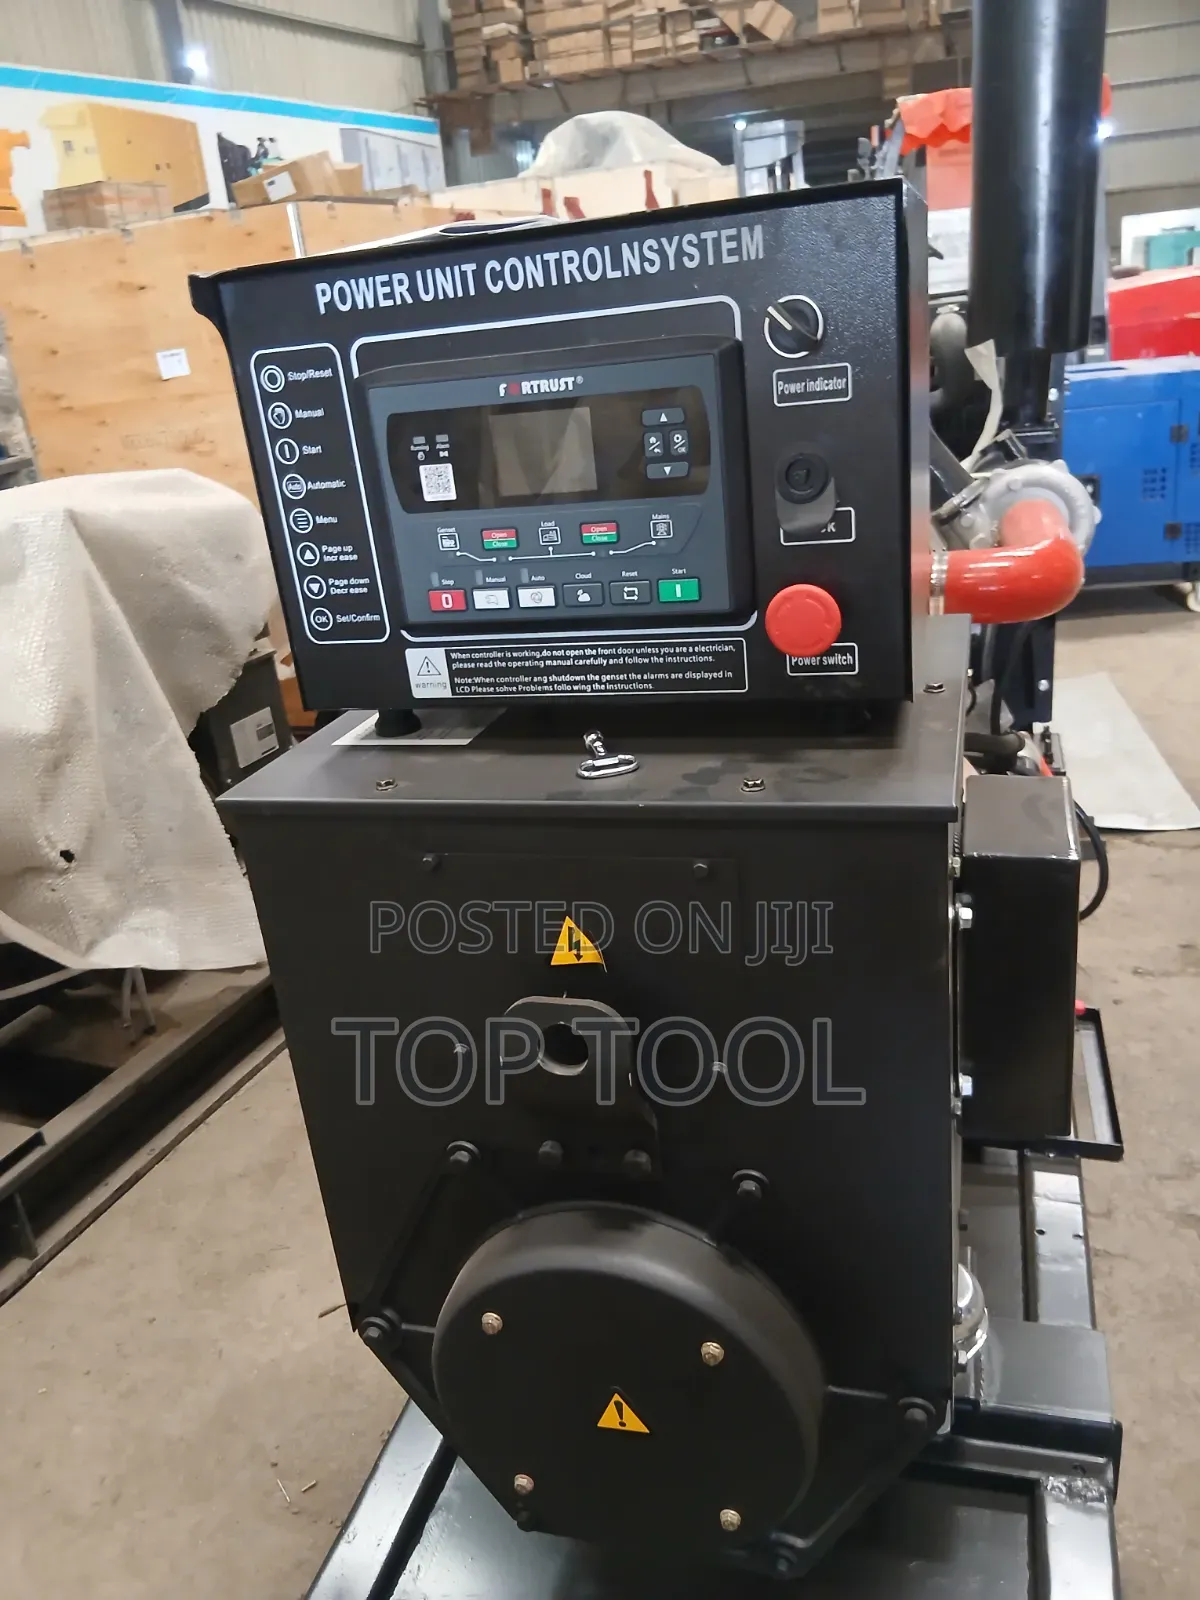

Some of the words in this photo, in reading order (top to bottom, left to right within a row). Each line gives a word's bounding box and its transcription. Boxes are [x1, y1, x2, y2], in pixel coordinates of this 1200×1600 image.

[315, 272, 413, 315] POWER
[416, 263, 477, 302] UNIT
[484, 224, 764, 294] CONTROLNSYSTEM
[287, 368, 333, 382] Stop/Reset
[777, 380, 805, 395] Power
[806, 376, 847, 393] indicator
[295, 408, 324, 419] Manual
[302, 445, 322, 455] Start
[307, 479, 347, 490] Automatic
[315, 515, 338, 524] Menu
[322, 545, 342, 555] Page
[343, 544, 354, 553] up
[575, 572, 592, 580] Cloud
[671, 567, 687, 575] Start
[328, 578, 348, 587] Page
[349, 577, 370, 585] down
[485, 575, 507, 583] Manual
[531, 574, 546, 582] Auto
[315, 615, 329, 623] OK
[450, 652, 470, 660] When
[471, 650, 504, 659] controller
[505, 650, 512, 658] is
[552, 649, 565, 657] not
[565, 649, 584, 658] open
[584, 647, 597, 656] the
[598, 647, 616, 656] front
[617, 646, 635, 655] door
[635, 646, 659, 654] unless
[660, 646, 674, 655] you
[694, 643, 736, 653] electrician,
[452, 661, 475, 670] please
[476, 660, 493, 668] read
[494, 659, 507, 668] the
[507, 659, 545, 669] operating
[545, 657, 573, 666] manual
[574, 656, 608, 667] carefully
[608, 656, 624, 665] and
[624, 655, 650, 664] follow
[650, 655, 664, 664] the
[665, 654, 716, 663] instructions.
[791, 656, 821, 667] Power
[822, 652, 853, 666] switch
[496, 674, 532, 683] controller
[548, 673, 586, 682] shutdown
[586, 673, 600, 681] the
[600, 673, 628, 683] genset
[628, 672, 642, 680] the
[642, 671, 669, 680] alarms
[684, 670, 723, 680] displayed
[724, 669, 733, 678] in
[415, 681, 447, 690] warning
[456, 685, 471, 693] LCD
[471, 685, 495, 693] Please
[518, 683, 554, 692] Problems
[592, 682, 606, 690] the
